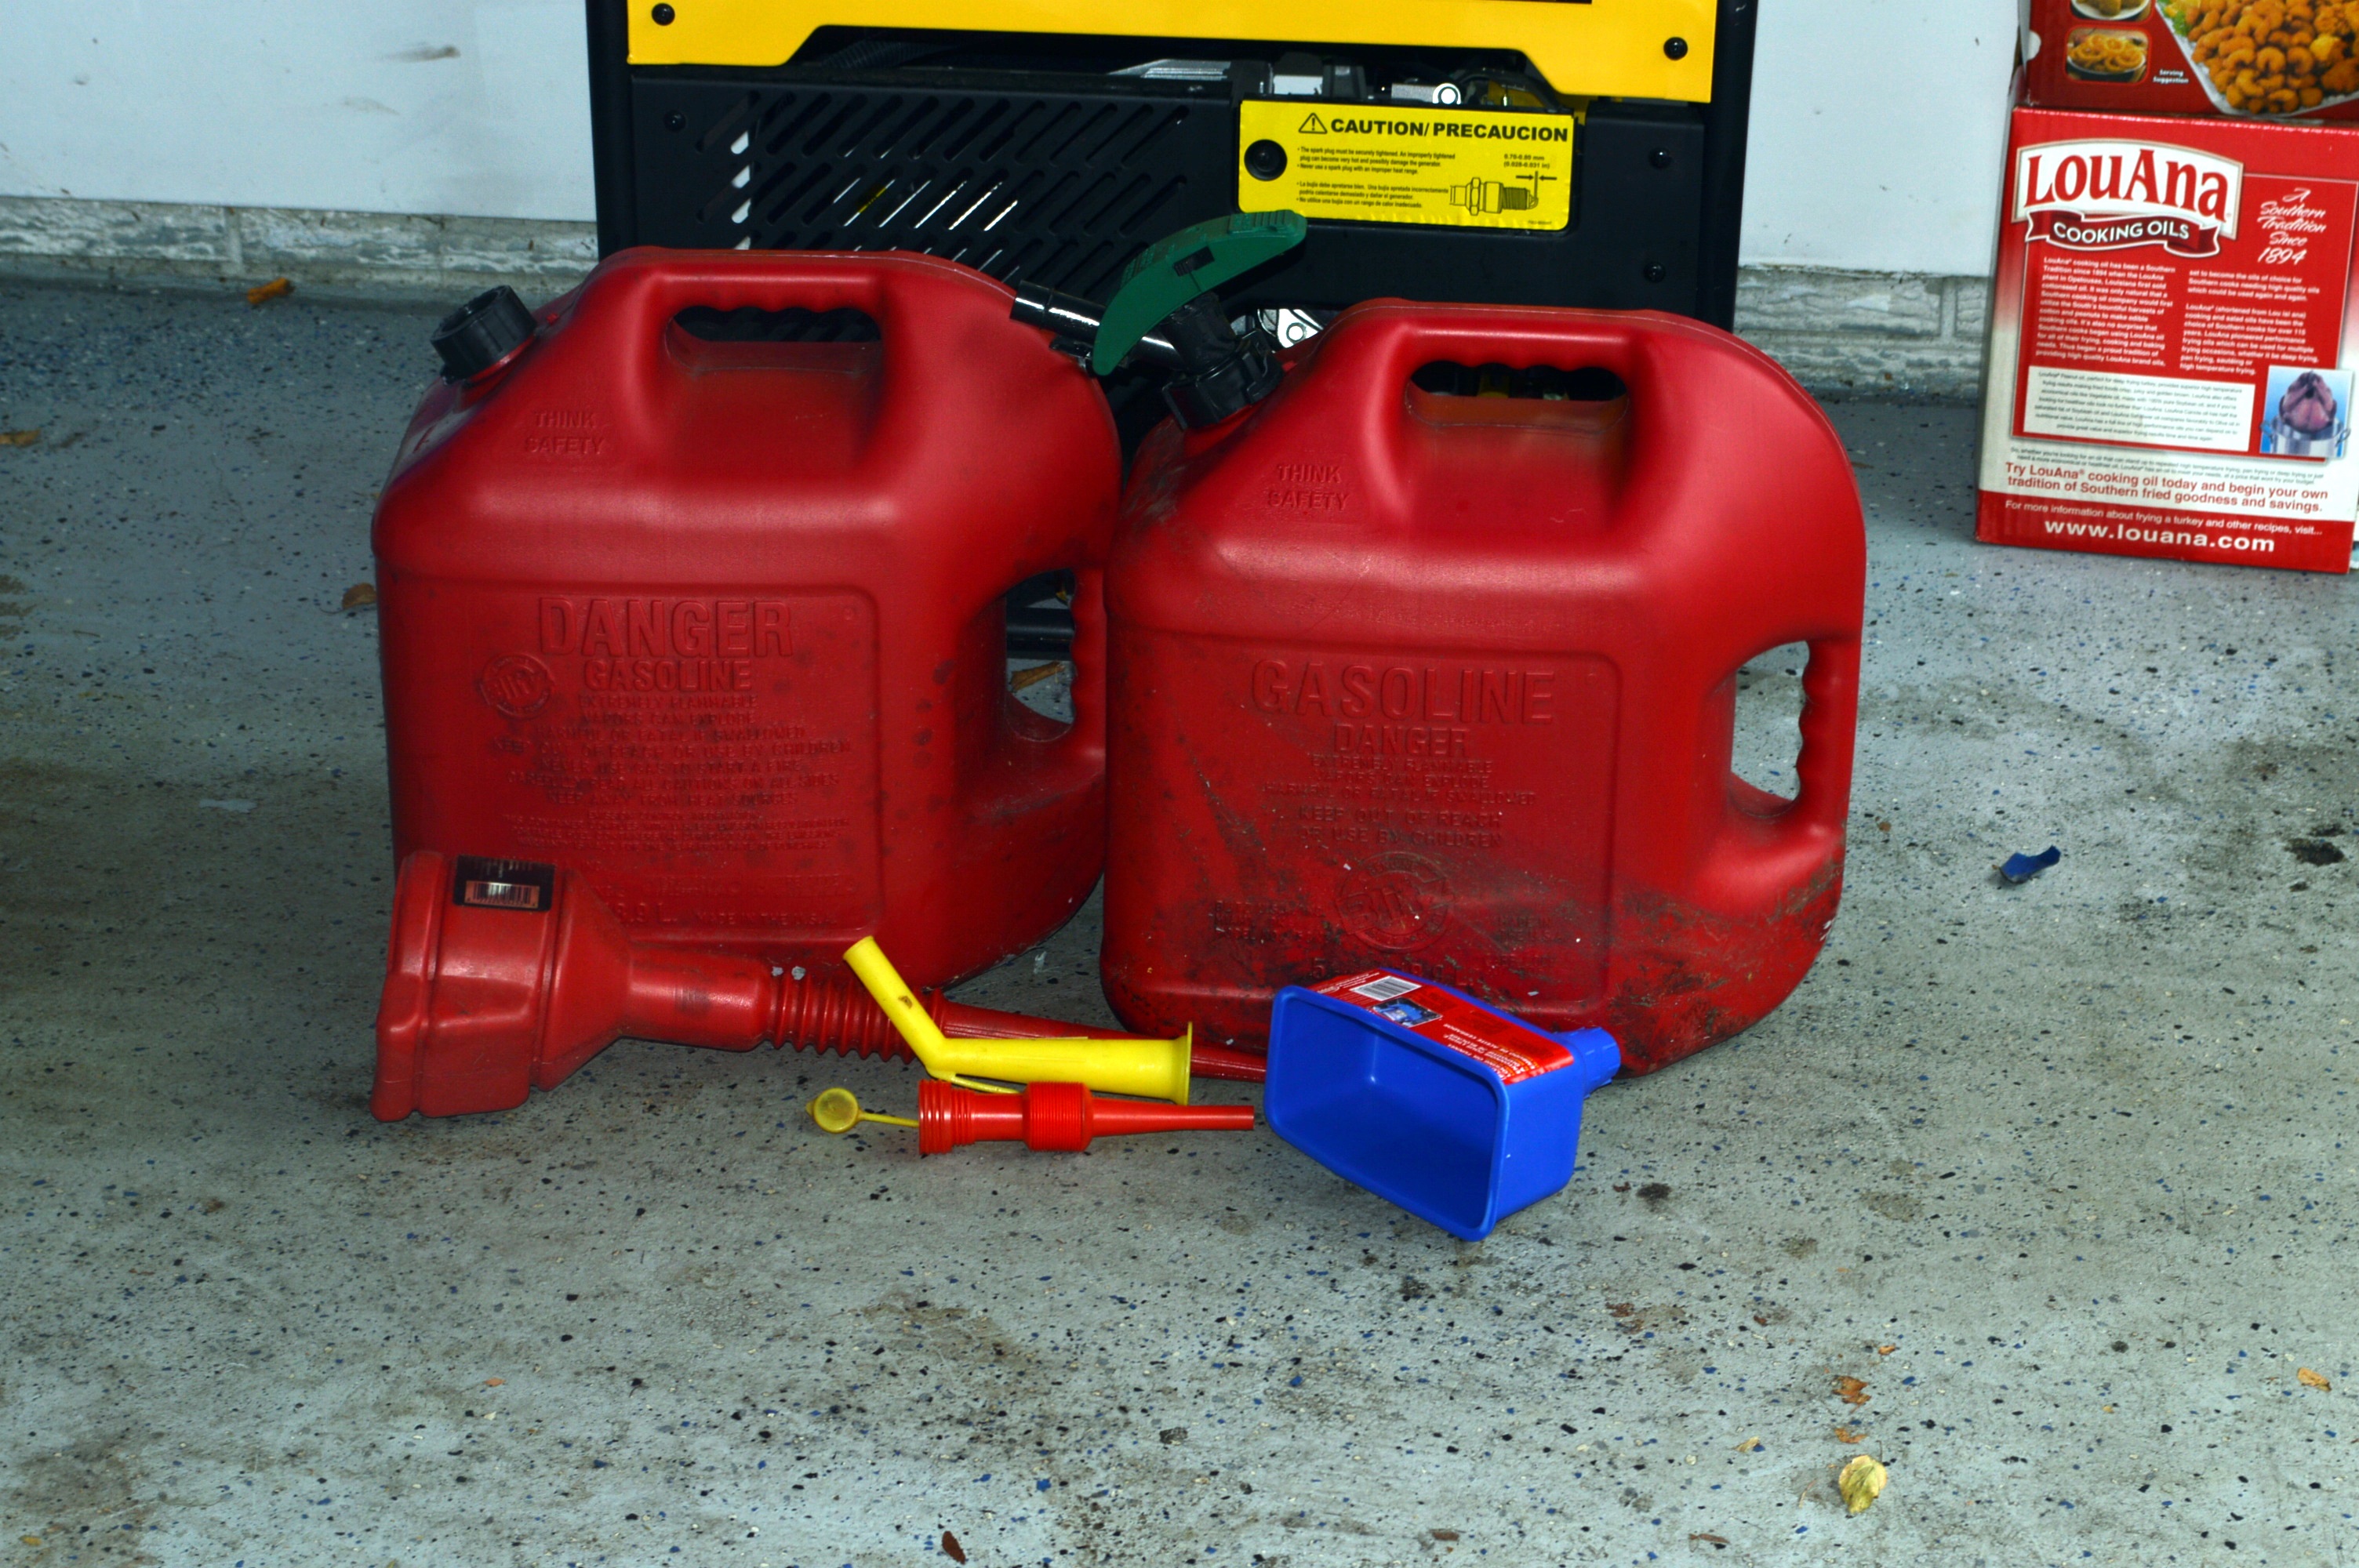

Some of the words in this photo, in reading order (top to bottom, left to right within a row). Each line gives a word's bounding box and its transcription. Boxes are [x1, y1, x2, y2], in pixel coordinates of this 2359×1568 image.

[1331, 118, 1430, 137] CAUTION/
[1434, 122, 1568, 142] PRECAUCION
[2024, 149, 2229, 223] LouAna
[2282, 187, 2311, 202] A
[2260, 201, 2326, 219] Southern
[2054, 222, 2143, 244] COOKING
[2147, 221, 2189, 240] OILS
[2257, 216, 2327, 233] Tradition
[2269, 230, 2308, 247] Since
[2257, 247, 2307, 265] 1894
[535, 411, 598, 428] THINK
[525, 437, 605, 455] SAFETY
[1278, 464, 1342, 483] THINK
[2005, 463, 2025, 477] Try
[2088, 472, 2139, 486] cooking
[2143, 475, 2158, 485] oil
[2161, 476, 2197, 491] today
[2201, 481, 2225, 491] and
[2229, 481, 2264, 495] begin
[2268, 487, 2297, 497] your
[2301, 489, 2328, 499] own
[1267, 491, 1350, 510] SAFETY
[2008, 477, 2060, 490] tradition
[2063, 481, 2077, 492] of
[2080, 483, 2138, 497] Southern
[2142, 488, 2171, 499] fried
[2174, 492, 2237, 505] goodness
[2241, 498, 2266, 507] and
[2269, 500, 2323, 514] savings.
[2005, 500, 2022, 509] For
[2050, 504, 2103, 516] information
[2106, 510, 2133, 518] about
[2135, 511, 2162, 524] frying
[2172, 514, 2203, 527] turkey
[2226, 520, 2251, 528] other
[2254, 523, 2292, 533] recipes,
[2045, 521, 2274, 552] www.louana.com
[539, 596, 793, 659] DANGER
[583, 659, 753, 692] GASOLINE
[1252, 659, 1554, 724] GASOLINE
[1333, 723, 1471, 757] DANGER
[1299, 805, 1344, 822] KEEP
[1354, 807, 1393, 823] OUT
[1405, 808, 1430, 825] OF
[1436, 808, 1503, 828] REACH
[1299, 826, 1321, 841] OR
[1332, 826, 1369, 843] USE
[1376, 828, 1401, 844] BY
[1411, 829, 1502, 848] CHILDREN
